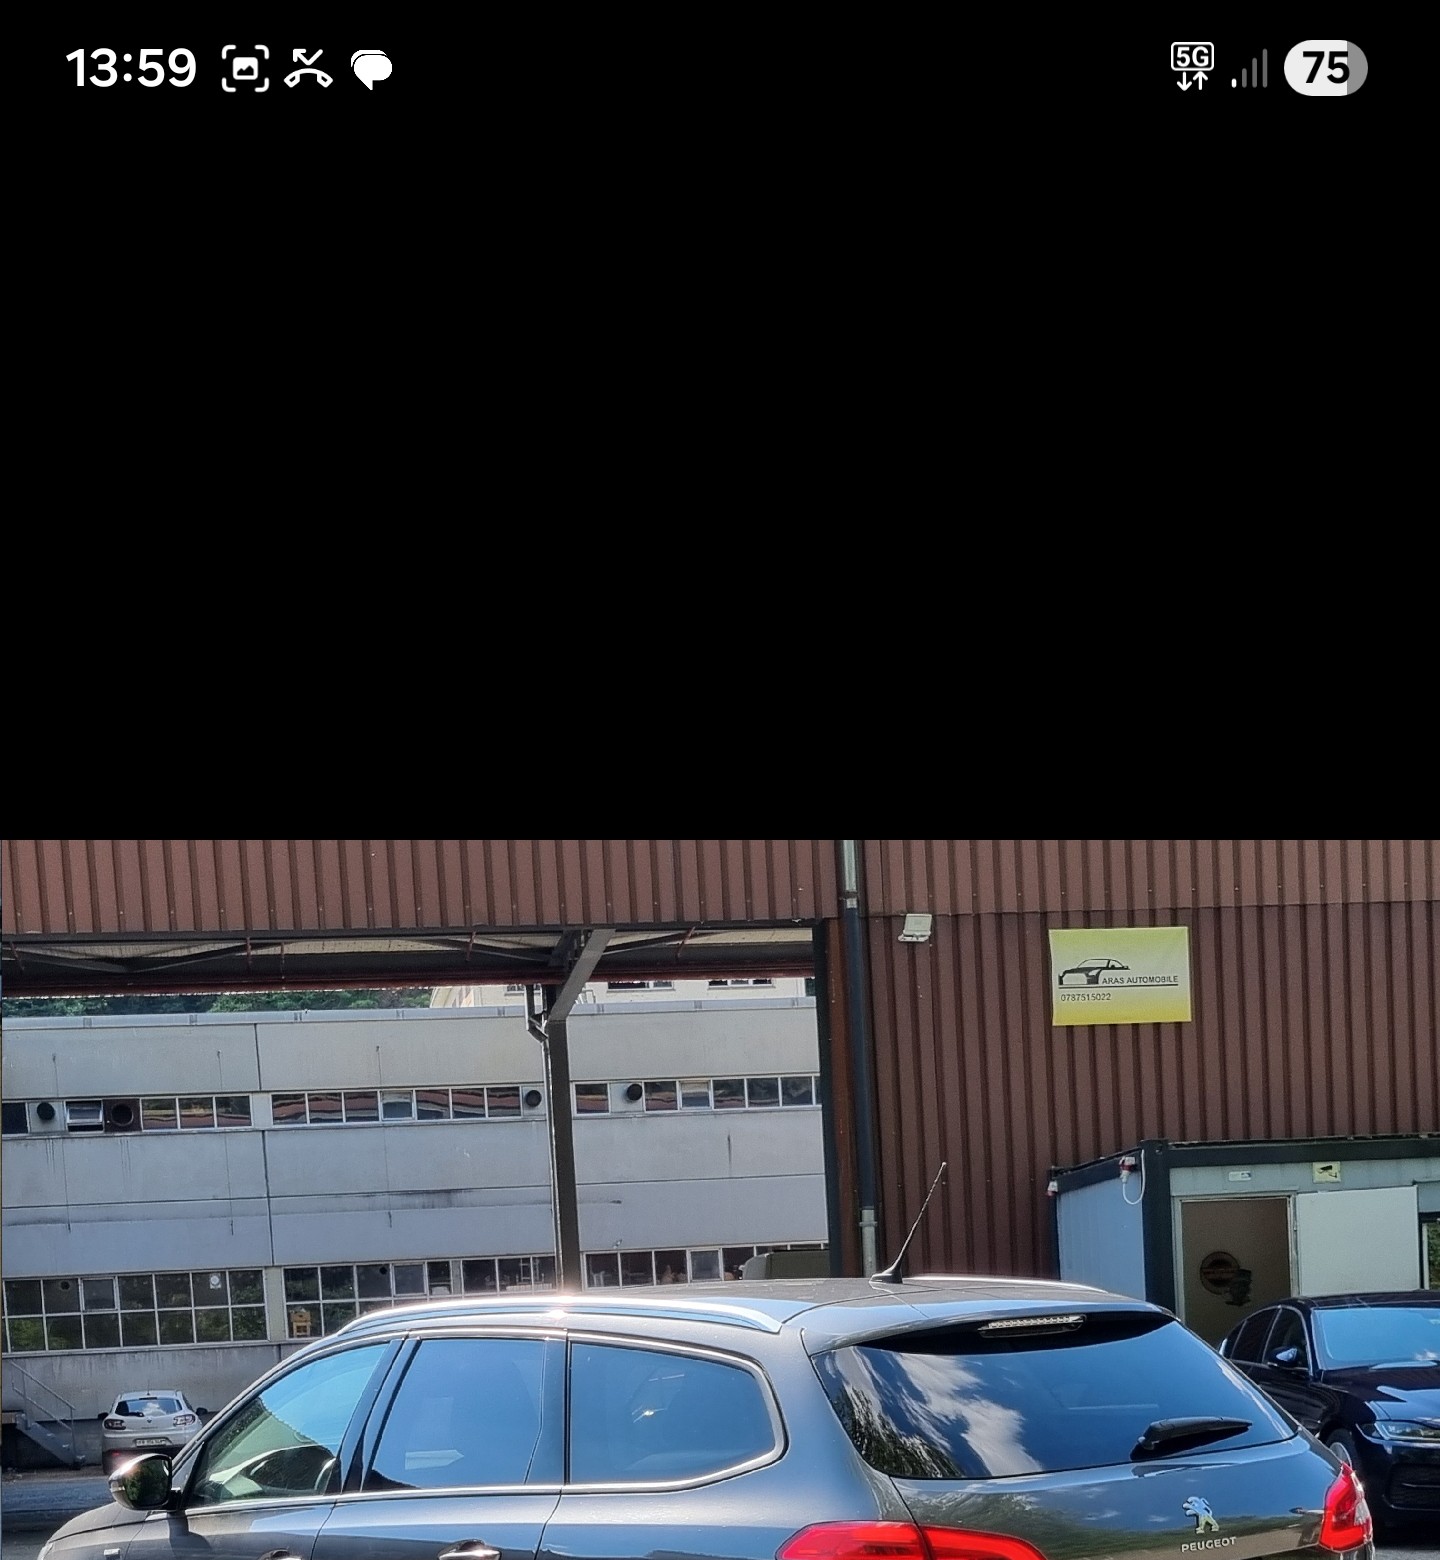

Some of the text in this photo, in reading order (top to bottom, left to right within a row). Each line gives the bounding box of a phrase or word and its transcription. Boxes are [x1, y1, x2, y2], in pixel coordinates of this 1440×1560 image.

[1101, 975, 1179, 985] ARAS AUTOMOBILE
[1060, 992, 1112, 1002] 0787515022
[1181, 1536, 1237, 1553] PEUGEOT
